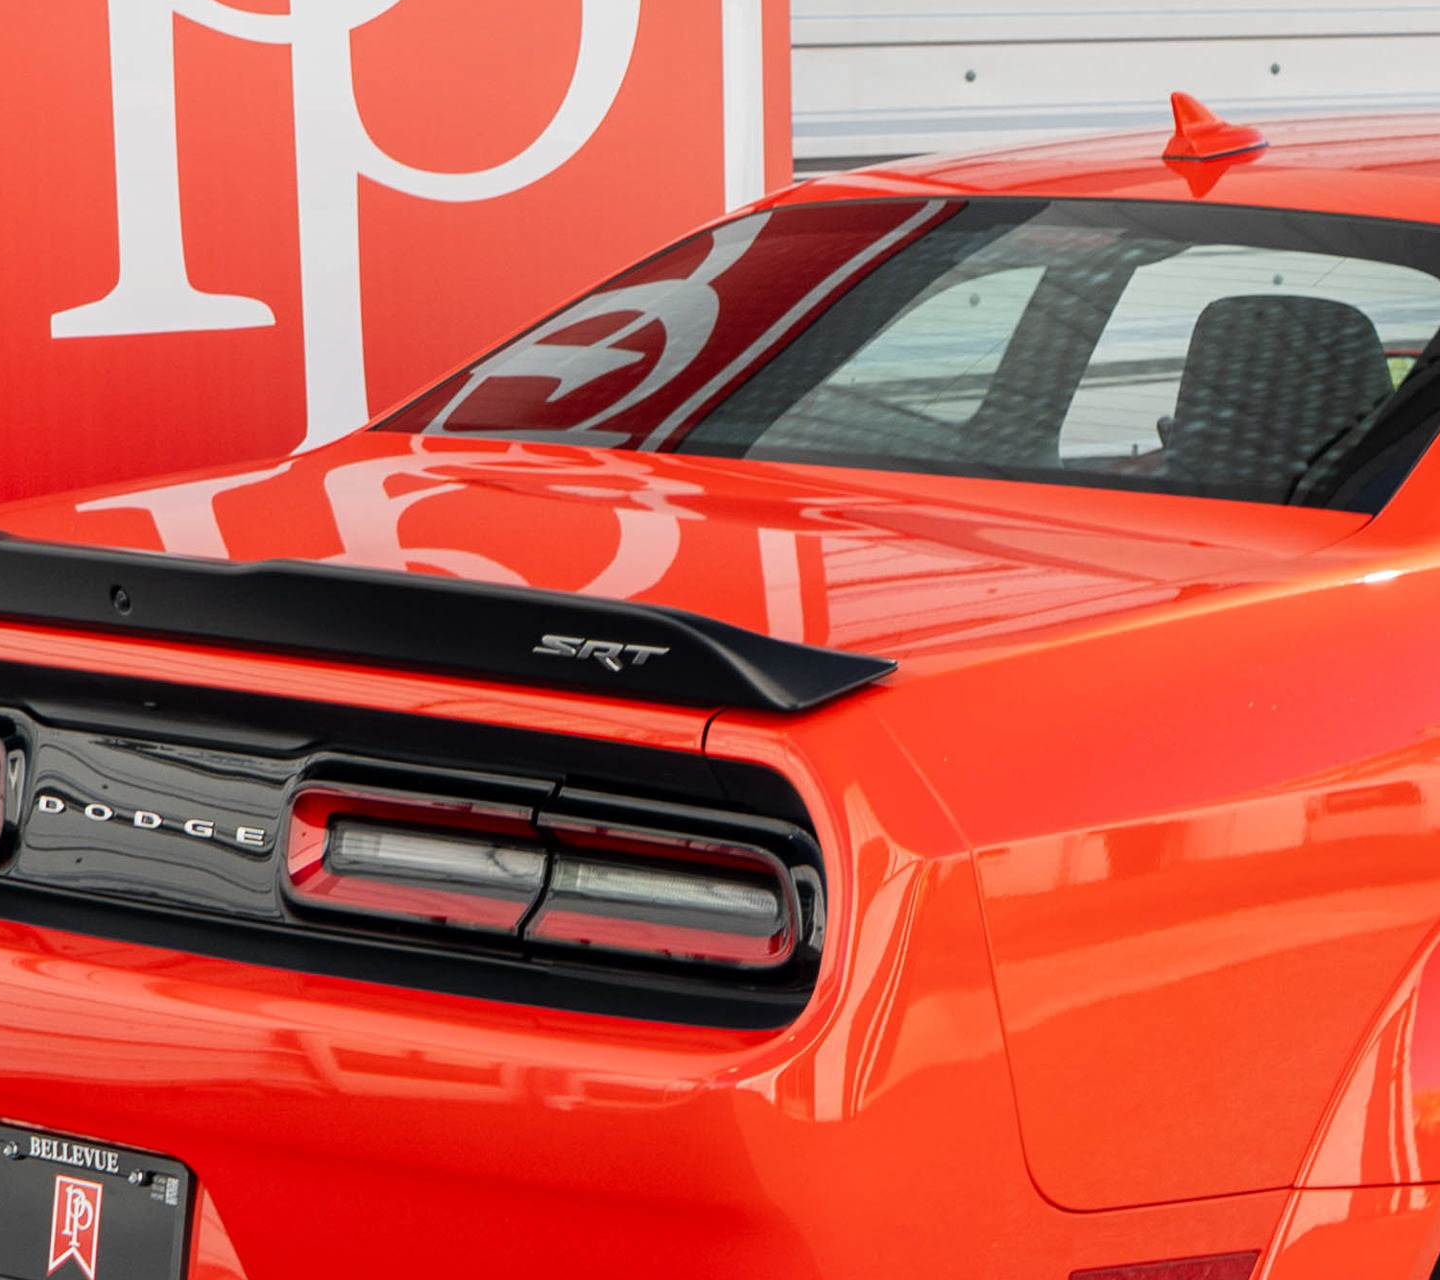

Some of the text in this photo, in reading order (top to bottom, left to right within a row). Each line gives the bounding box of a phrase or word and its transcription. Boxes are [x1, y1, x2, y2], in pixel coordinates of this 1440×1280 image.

[532, 634, 671, 672] SRT
[38, 795, 266, 846] DODGE
[29, 1136, 120, 1174] BELLEVUE
